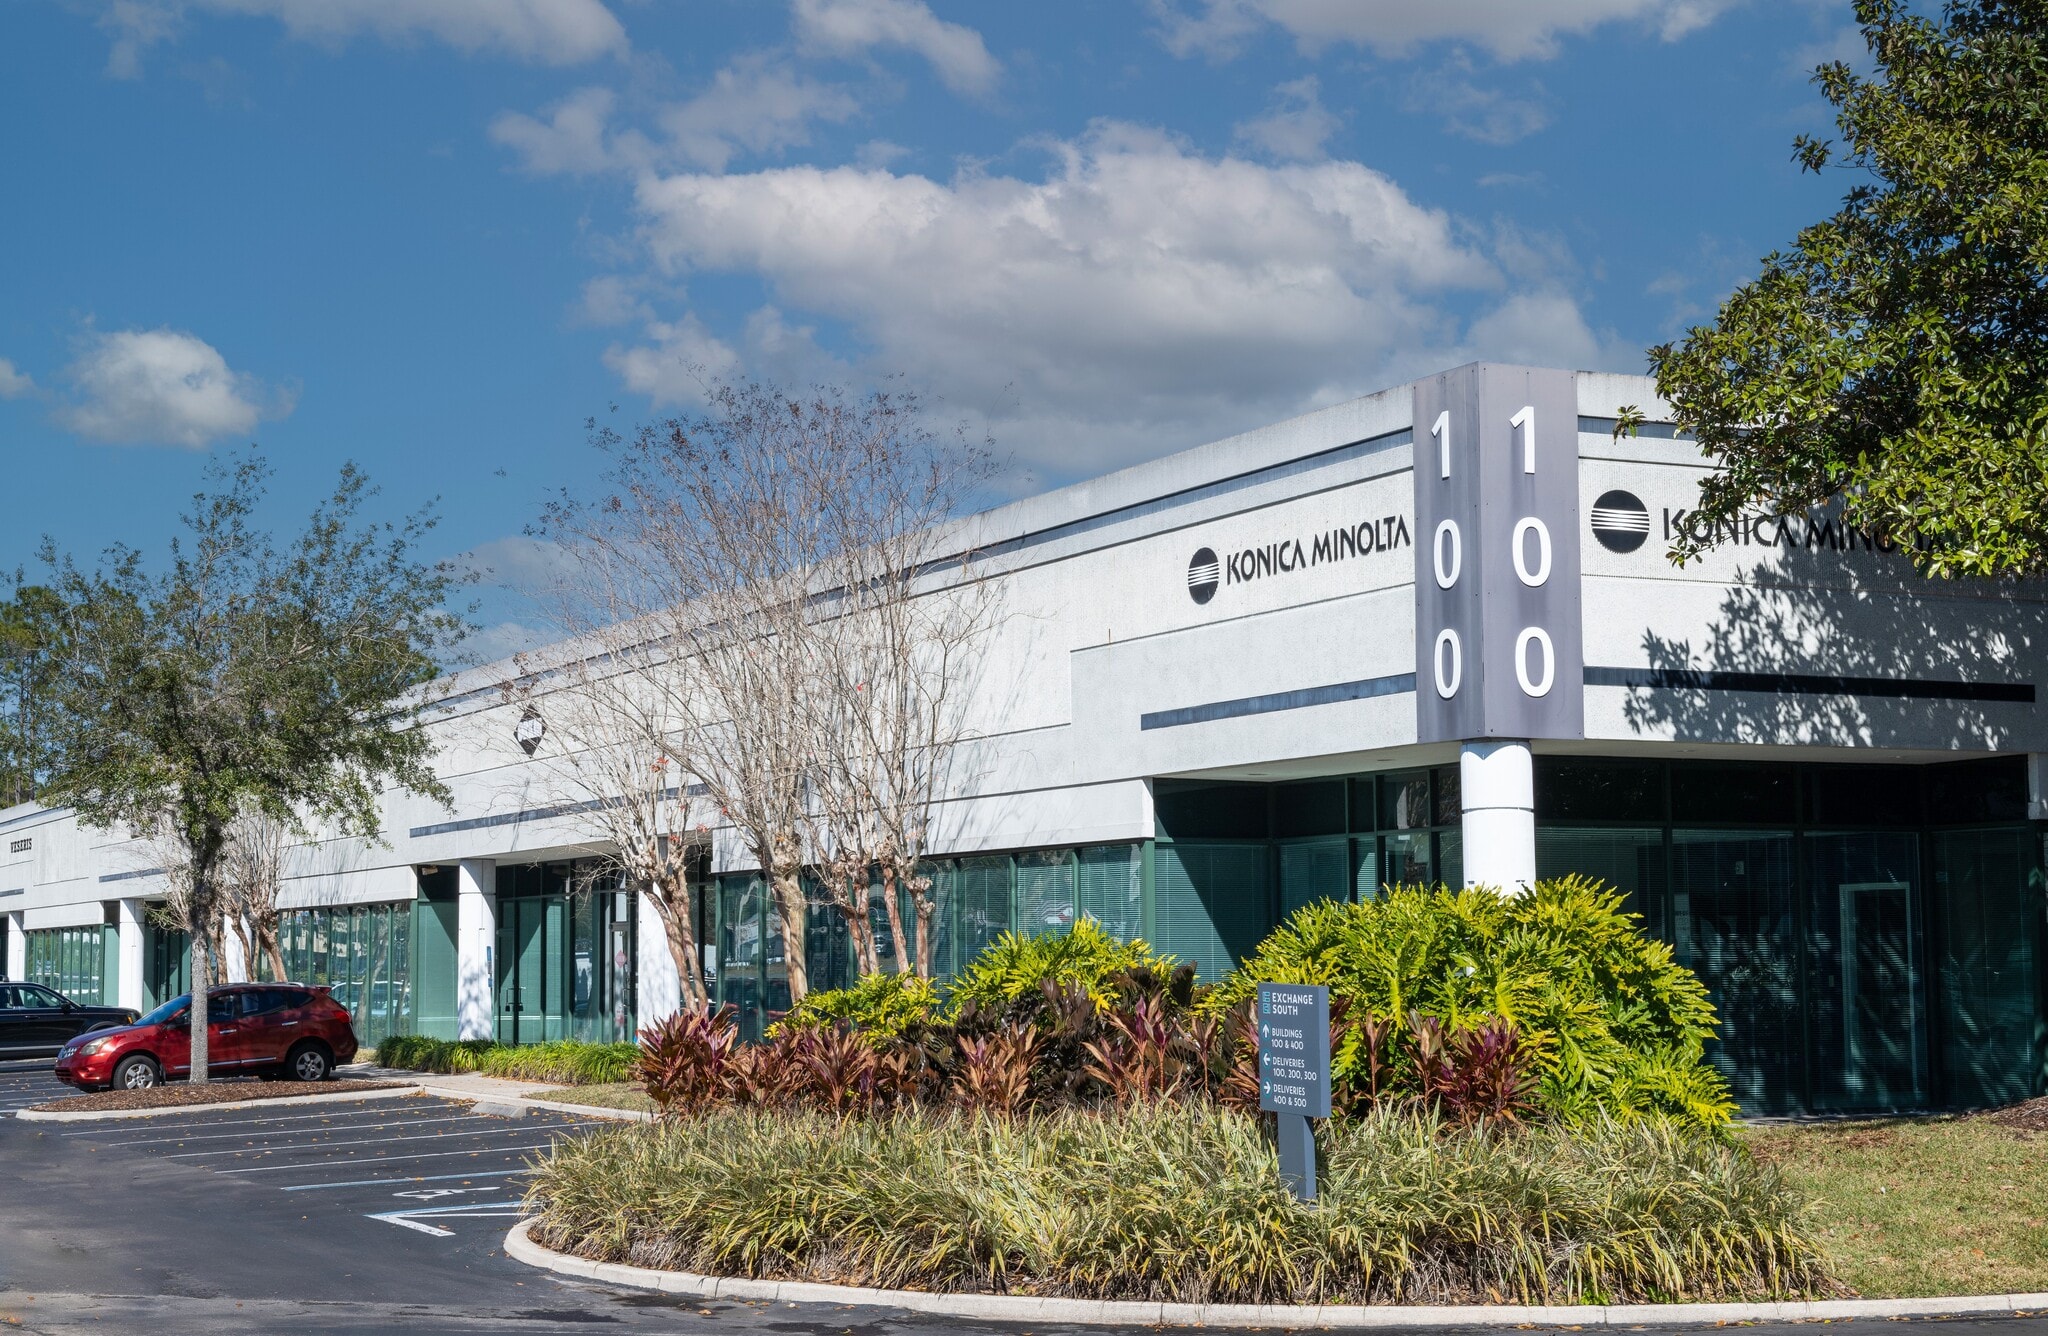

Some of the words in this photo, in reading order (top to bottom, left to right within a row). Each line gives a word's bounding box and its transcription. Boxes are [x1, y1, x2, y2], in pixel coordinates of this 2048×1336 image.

[1227, 538, 1306, 585] KONICA
[1312, 514, 1411, 566] MINOLTA
[1272, 992, 1313, 1005] EXCHANGE
[1272, 1004, 1298, 1015] SOUTH
[1272, 1028, 1302, 1039] BUILDINGS
[1271, 1039, 1283, 1048] 100
[1284, 1040, 1289, 1049] &
[1290, 1041, 1304, 1050] 400
[1273, 1056, 1305, 1068] DELIVERIES
[1273, 1068, 1287, 1078] 100,
[1288, 1070, 1303, 1080] 200,
[1273, 1084, 1306, 1096] DELIVERIES
[1274, 1095, 1287, 1105] 400
[1287, 1097, 1293, 1106] &
[1294, 1098, 1307, 1107] 500
